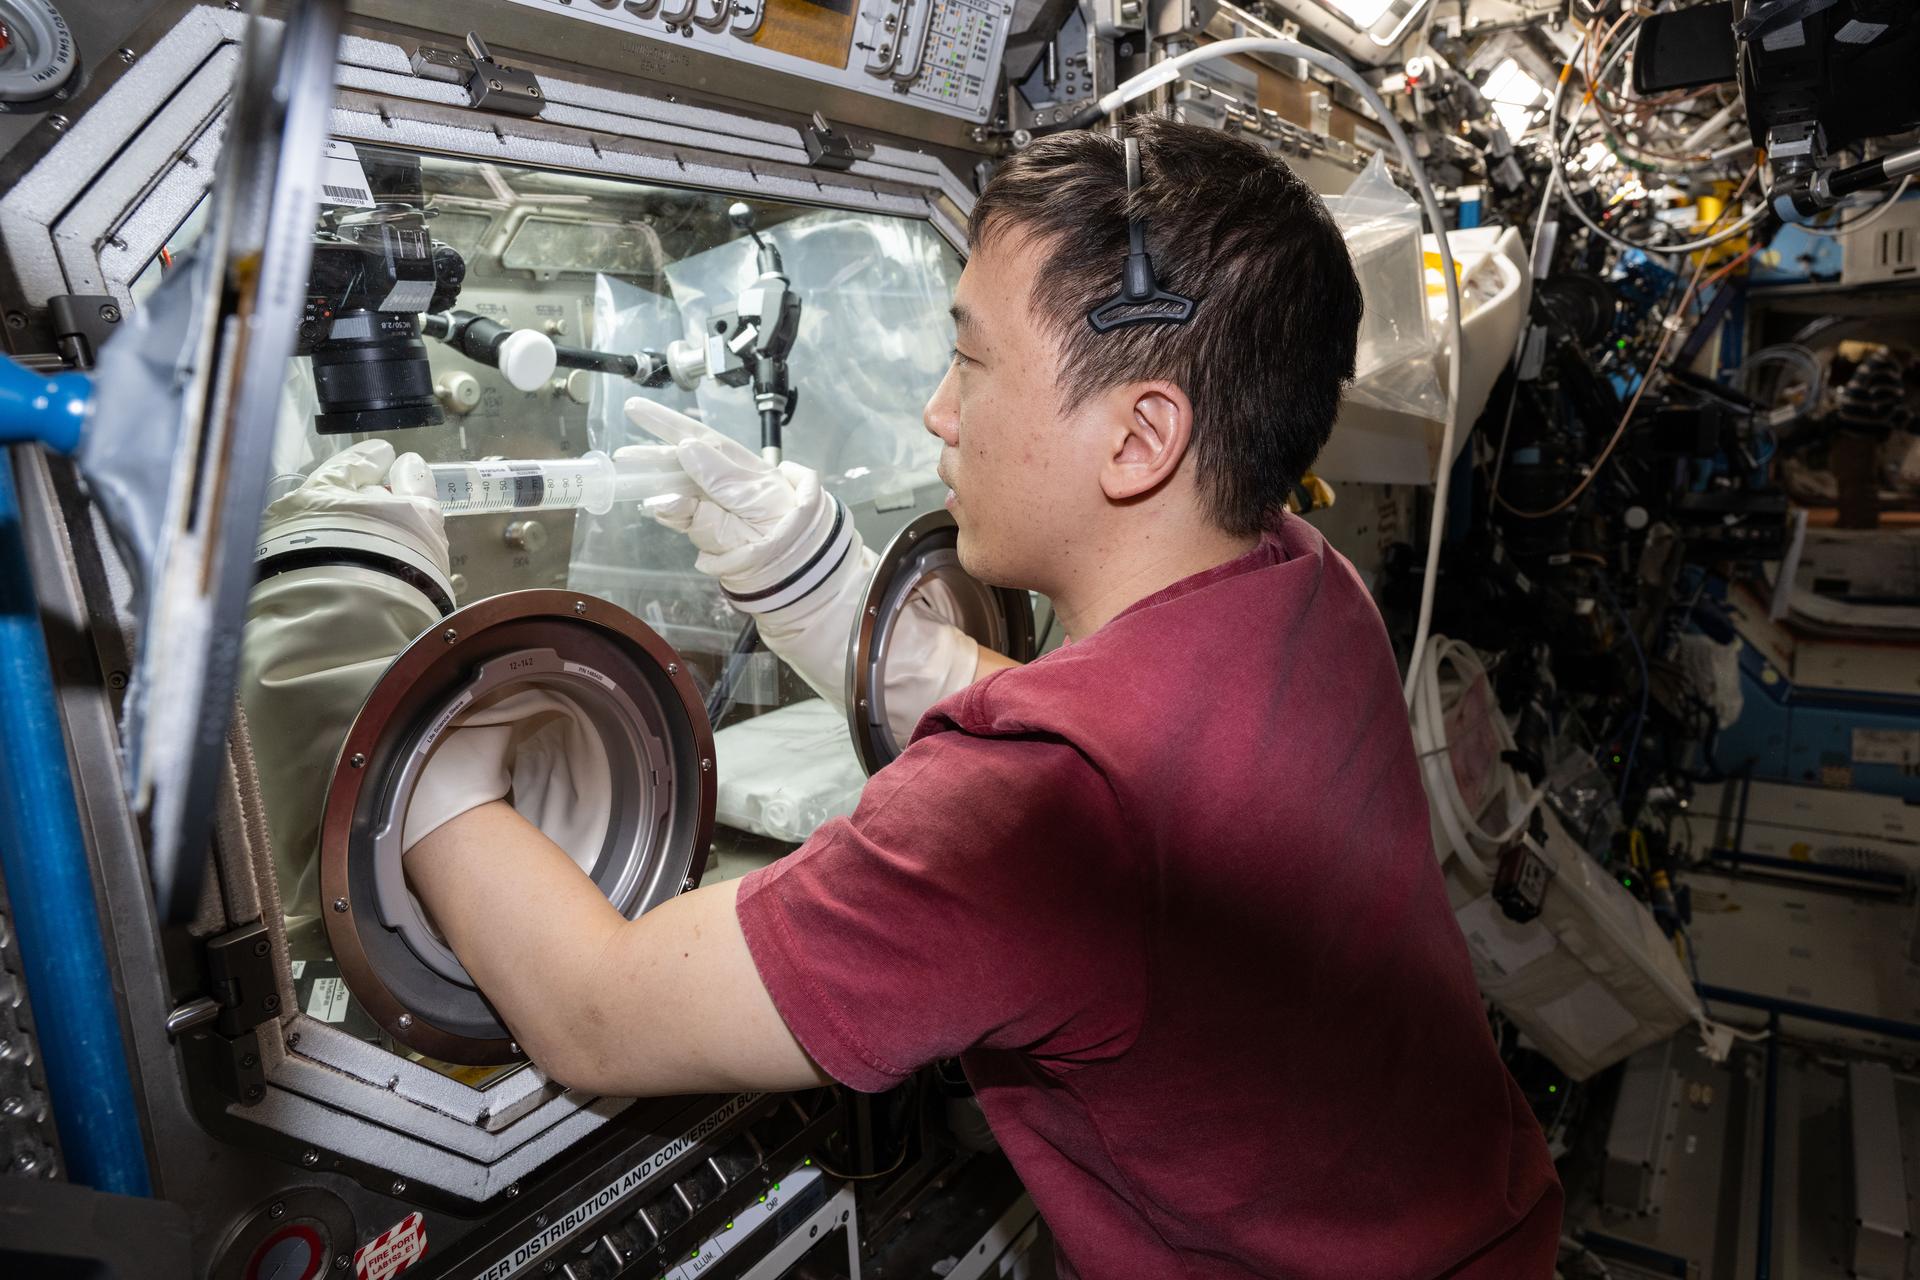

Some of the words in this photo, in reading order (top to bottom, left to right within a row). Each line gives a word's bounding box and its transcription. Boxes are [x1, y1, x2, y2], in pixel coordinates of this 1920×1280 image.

[448, 482, 456, 493] 20
[465, 481, 474, 493] 30
[484, 481, 490, 492] 40
[499, 480, 507, 491] 50
[516, 479, 523, 490] 60
[548, 478, 555, 489] 80
[563, 478, 570, 488] 90
[509, 657, 534, 671] 12-142
[427, 732, 437, 744] Life
[434, 715, 450, 733] Science
[515, 1185, 620, 1266] DISTRIBUTION
[623, 1163, 652, 1195] AND
[654, 1104, 736, 1168] CONVERSION
[766, 1197, 780, 1212] CMP
[368, 1249, 390, 1269] FIRE
[391, 1231, 415, 1253] PORT
[693, 1251, 718, 1273] ILLUM.
